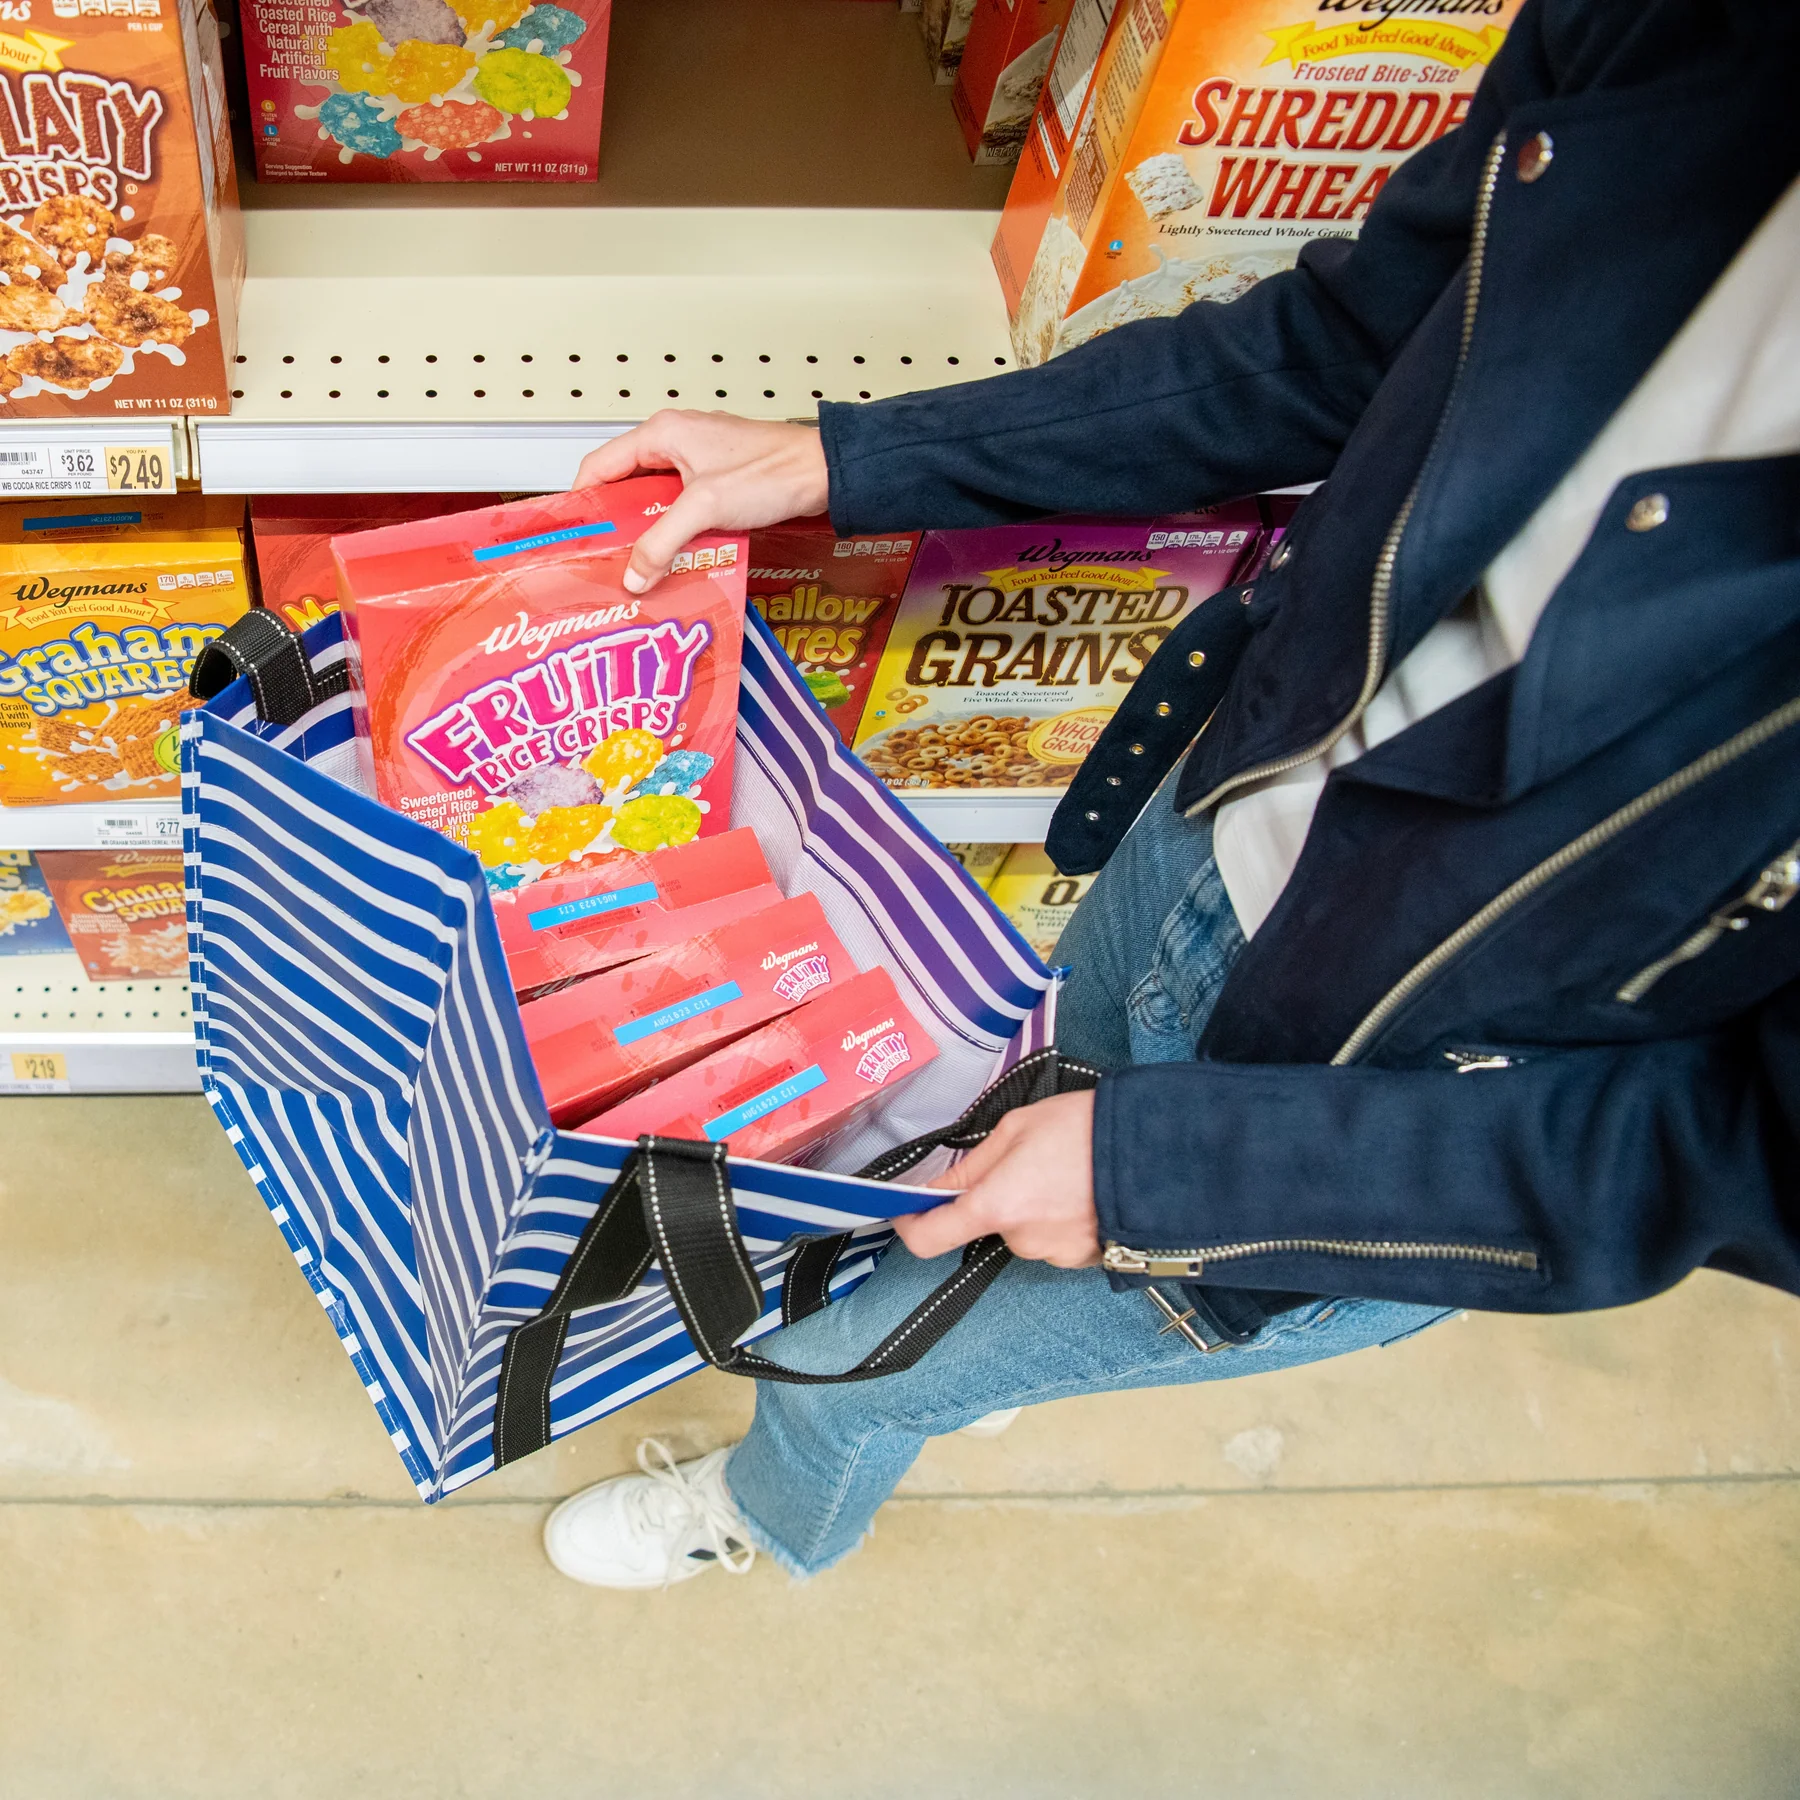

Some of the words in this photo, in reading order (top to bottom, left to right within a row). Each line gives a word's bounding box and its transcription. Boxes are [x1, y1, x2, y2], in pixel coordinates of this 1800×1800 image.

[253, 4, 303, 21] Toasted
[308, 8, 336, 22] Rice
[259, 19, 300, 35] Cereal
[304, 22, 333, 36] with
[267, 35, 314, 51] Natural
[318, 38, 328, 51] &
[1302, 36, 1338, 58] Food
[1343, 32, 1368, 47] You
[1371, 30, 1400, 44] Feel
[1401, 31, 1434, 47] Good
[0, 42, 31, 64] bout
[271, 50, 326, 66] Artificial
[260, 64, 290, 79] Fruit
[293, 66, 340, 80] Flavors
[1294, 64, 1369, 82] Frosted
[1373, 65, 1460, 83] Bite-Size
[1176, 77, 1476, 150] SHREDDE
[0, 71, 163, 180] LATY
[495, 163, 512, 173] NET
[515, 163, 530, 173] WT
[532, 163, 541, 173] 11
[544, 163, 557, 174] OZ
[559, 163, 588, 176] (311g)
[1207, 156, 1394, 219] WHEA
[1160, 224, 1201, 237] Lightly
[1206, 226, 1272, 237] Sweetened
[1275, 228, 1315, 237] Whole
[1317, 228, 1353, 238] Grain
[115, 399, 134, 409] NET
[138, 399, 153, 409] WT
[155, 399, 167, 408] 11
[170, 398, 184, 408] OZ
[186, 398, 217, 409] (311g)
[61, 454, 95, 472] $3.62
[110, 454, 163, 489] $2.49
[2, 482, 12, 490] WB
[13, 482, 34, 490] COCOA
[35, 481, 49, 490] RICE
[50, 481, 72, 490] CRISPS
[74, 481, 82, 489] 11
[83, 481, 92, 489] OZ
[1015, 538, 1156, 572] Wegmans
[748, 568, 822, 580] mans
[1011, 573, 1038, 587] Food
[1039, 571, 1058, 581] You
[1060, 570, 1080, 580] Feel
[1081, 570, 1106, 581] Good
[11, 577, 147, 608] Wegmans
[26, 610, 49, 625] Food
[49, 608, 67, 618] You
[68, 603, 87, 613] Feel
[88, 603, 115, 612] Good
[117, 605, 146, 617] About
[938, 583, 1190, 626] TOASTED
[477, 600, 641, 659] Wegmans
[905, 625, 1175, 687] GRAINS
[0, 703, 28, 711] Grain
[7, 711, 29, 720] with
[0, 721, 31, 729] Honey
[1075, 716, 1098, 724] made
[1050, 720, 1103, 742] WHOL
[401, 786, 473, 810] Sweetened
[401, 804, 447, 821] oasted
[451, 800, 479, 814] Rice
[447, 811, 475, 826] with
[460, 824, 470, 837] &
[113, 851, 183, 865] Wegma
[82, 881, 185, 913] Cinna
[118, 898, 186, 922] SQUA
[760, 941, 819, 970] Wegmans
[840, 1017, 896, 1051] Wegmans
